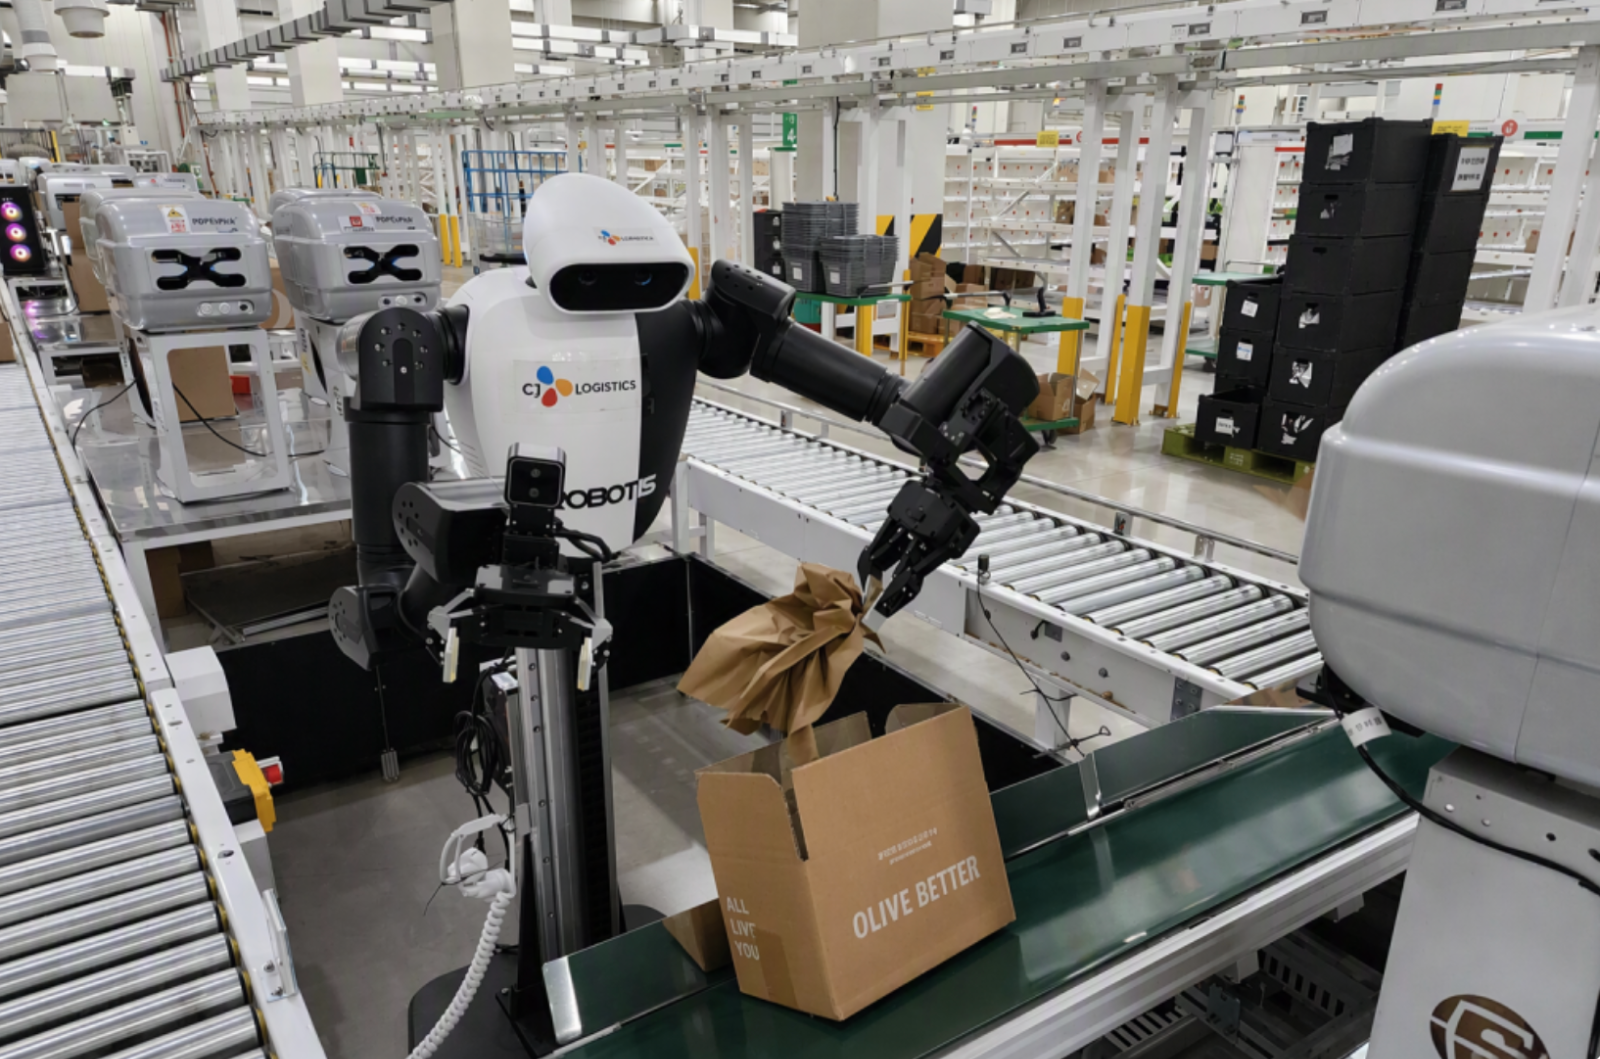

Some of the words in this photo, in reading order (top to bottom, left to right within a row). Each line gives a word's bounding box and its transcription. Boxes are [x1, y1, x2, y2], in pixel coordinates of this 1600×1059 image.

[522, 383, 541, 398] CJ
[575, 380, 636, 395] LOGISTICS
[726, 896, 750, 915] ALL
[853, 888, 914, 939] OLIVE
[915, 855, 981, 908] BETTER
[734, 940, 760, 961] YOU
